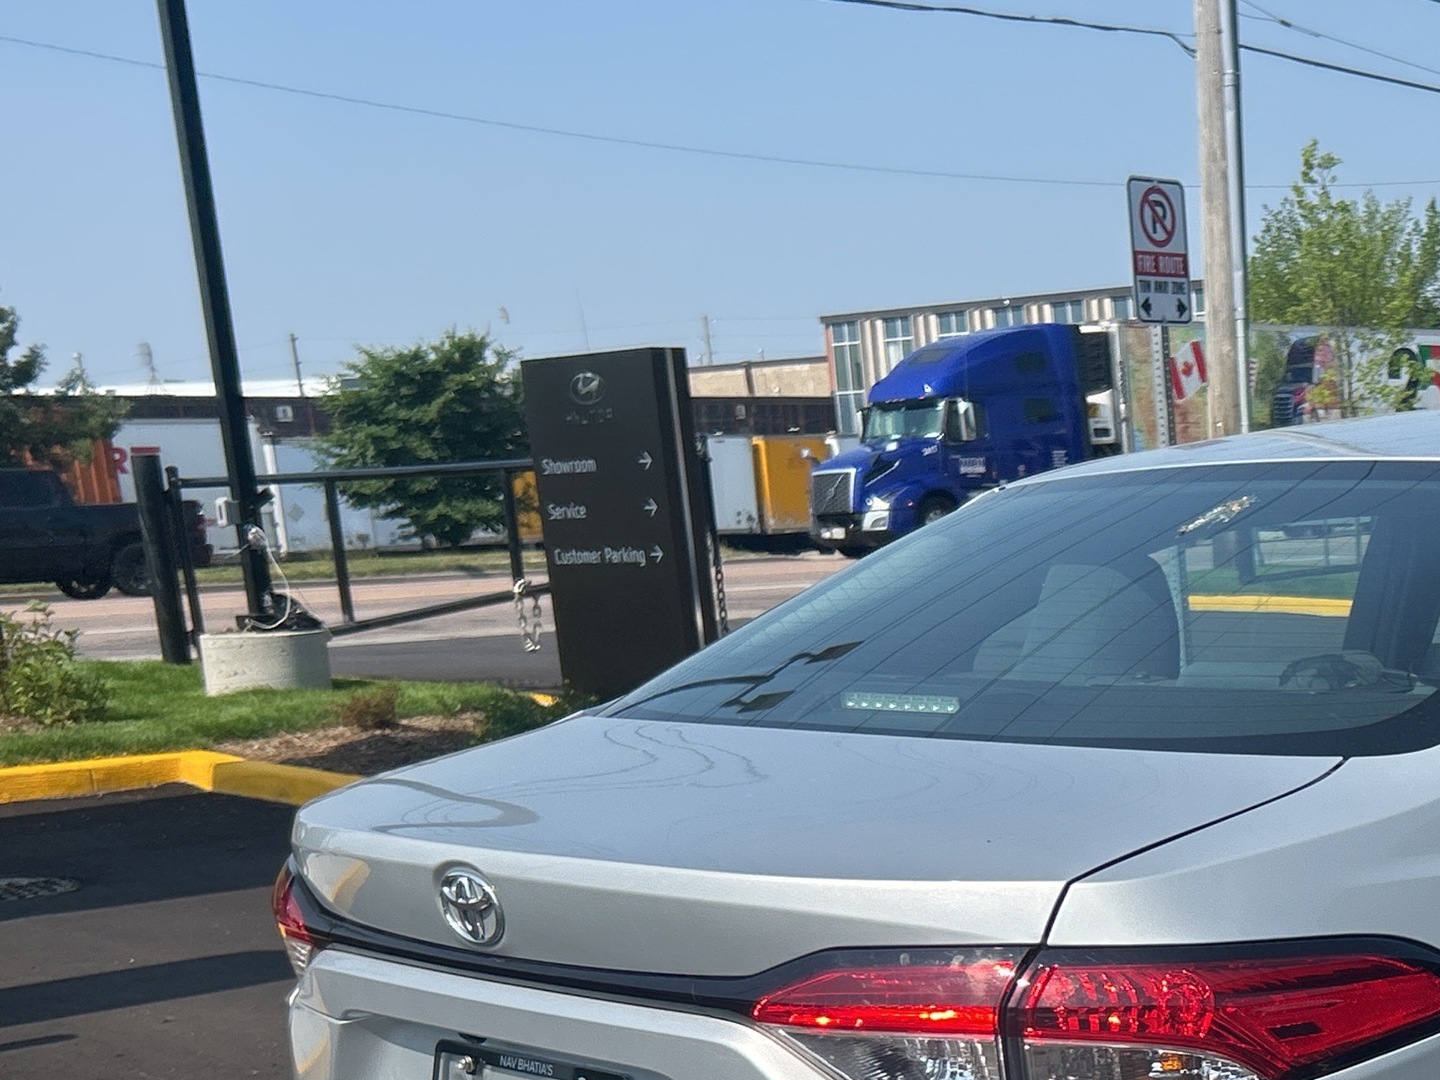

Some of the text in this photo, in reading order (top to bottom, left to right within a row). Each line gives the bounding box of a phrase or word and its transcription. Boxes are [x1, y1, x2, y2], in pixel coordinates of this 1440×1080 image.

[1137, 254, 1185, 275] FIRE ROUTE
[542, 458, 597, 475] Showroom
[548, 502, 587, 520] Service
[554, 547, 646, 567] Customer Parking
[500, 1055, 553, 1076] NAV BHATIA'S
